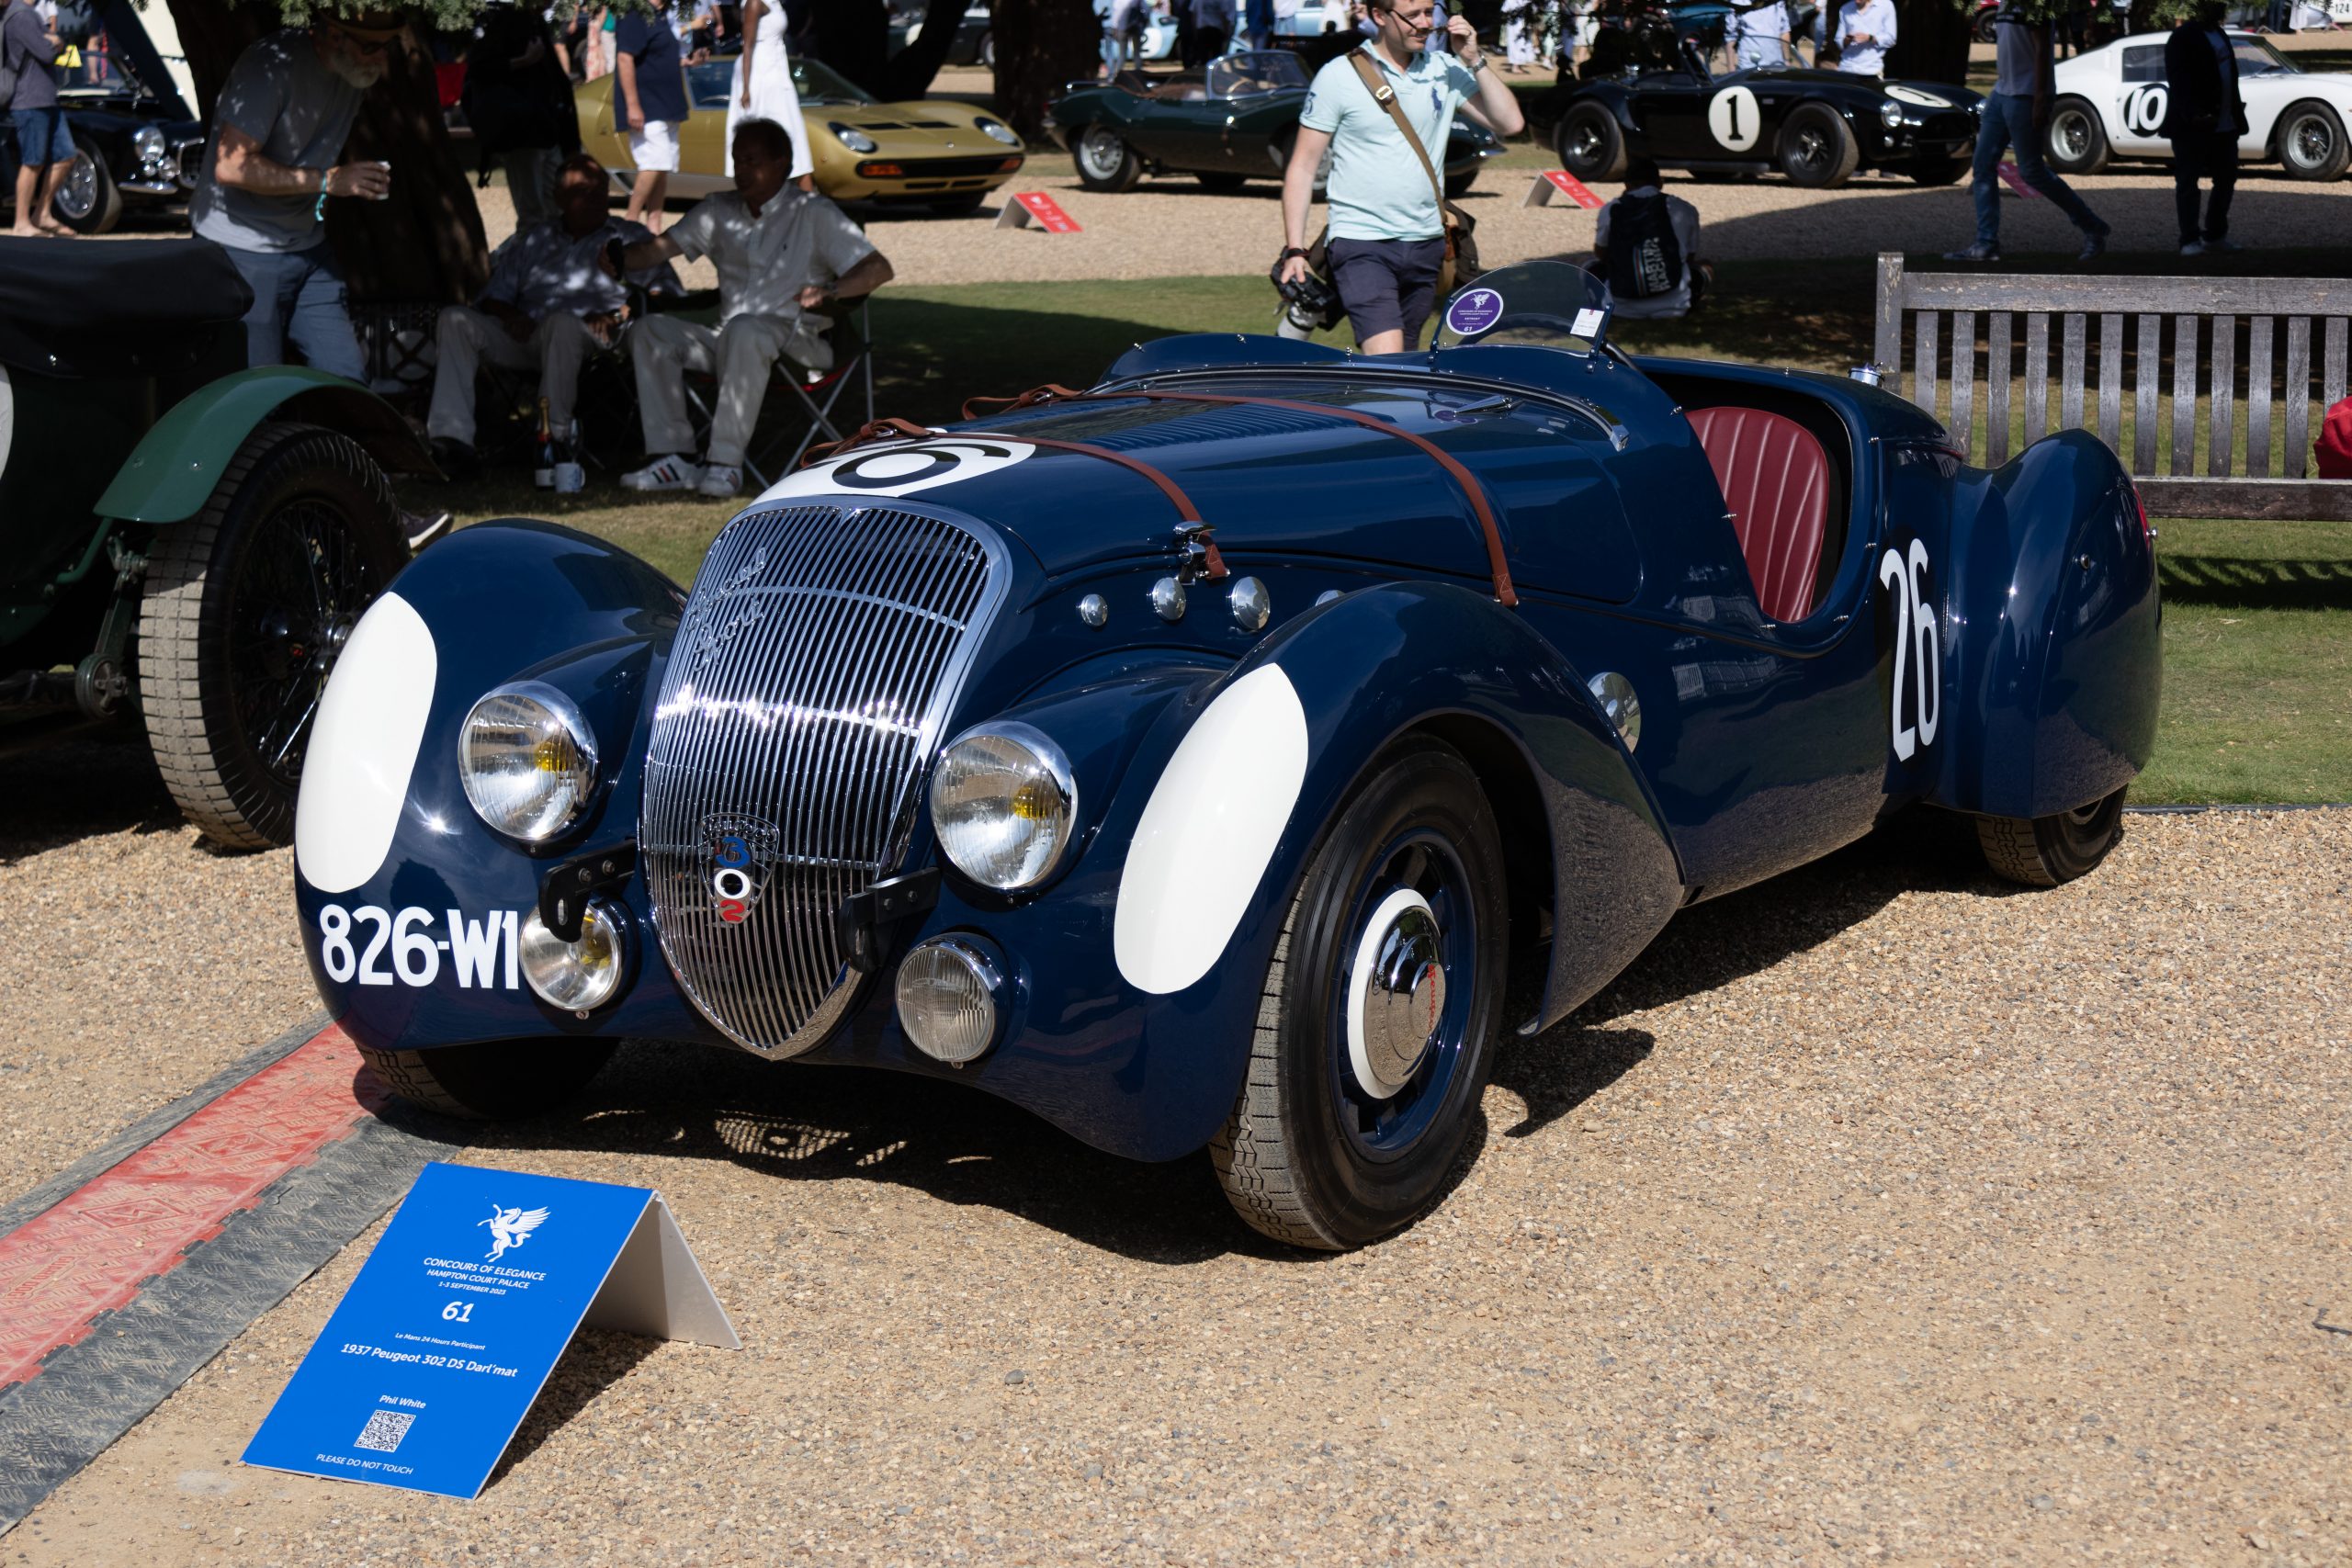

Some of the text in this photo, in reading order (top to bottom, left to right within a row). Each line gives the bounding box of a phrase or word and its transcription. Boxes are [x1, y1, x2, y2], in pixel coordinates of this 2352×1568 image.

[1726, 94, 1744, 141] 1
[2128, 87, 2167, 130] 10
[1880, 538, 1939, 761] 26
[424, 1258, 547, 1280] CONCOURS OF ELEGANCE
[427, 1269, 530, 1289] HAMPTON COURT PALACE
[450, 1282, 490, 1293] SEPTEMBER
[441, 1301, 475, 1323] 61
[431, 1337, 450, 1346] Hours
[451, 1340, 486, 1350] Participant
[341, 1343, 518, 1378] 1937 Peugeot 302 DS Darl'mat
[379, 1394, 426, 1409] Phil White
[316, 1453, 413, 1475] PLEASE DO NOT TOUCH
